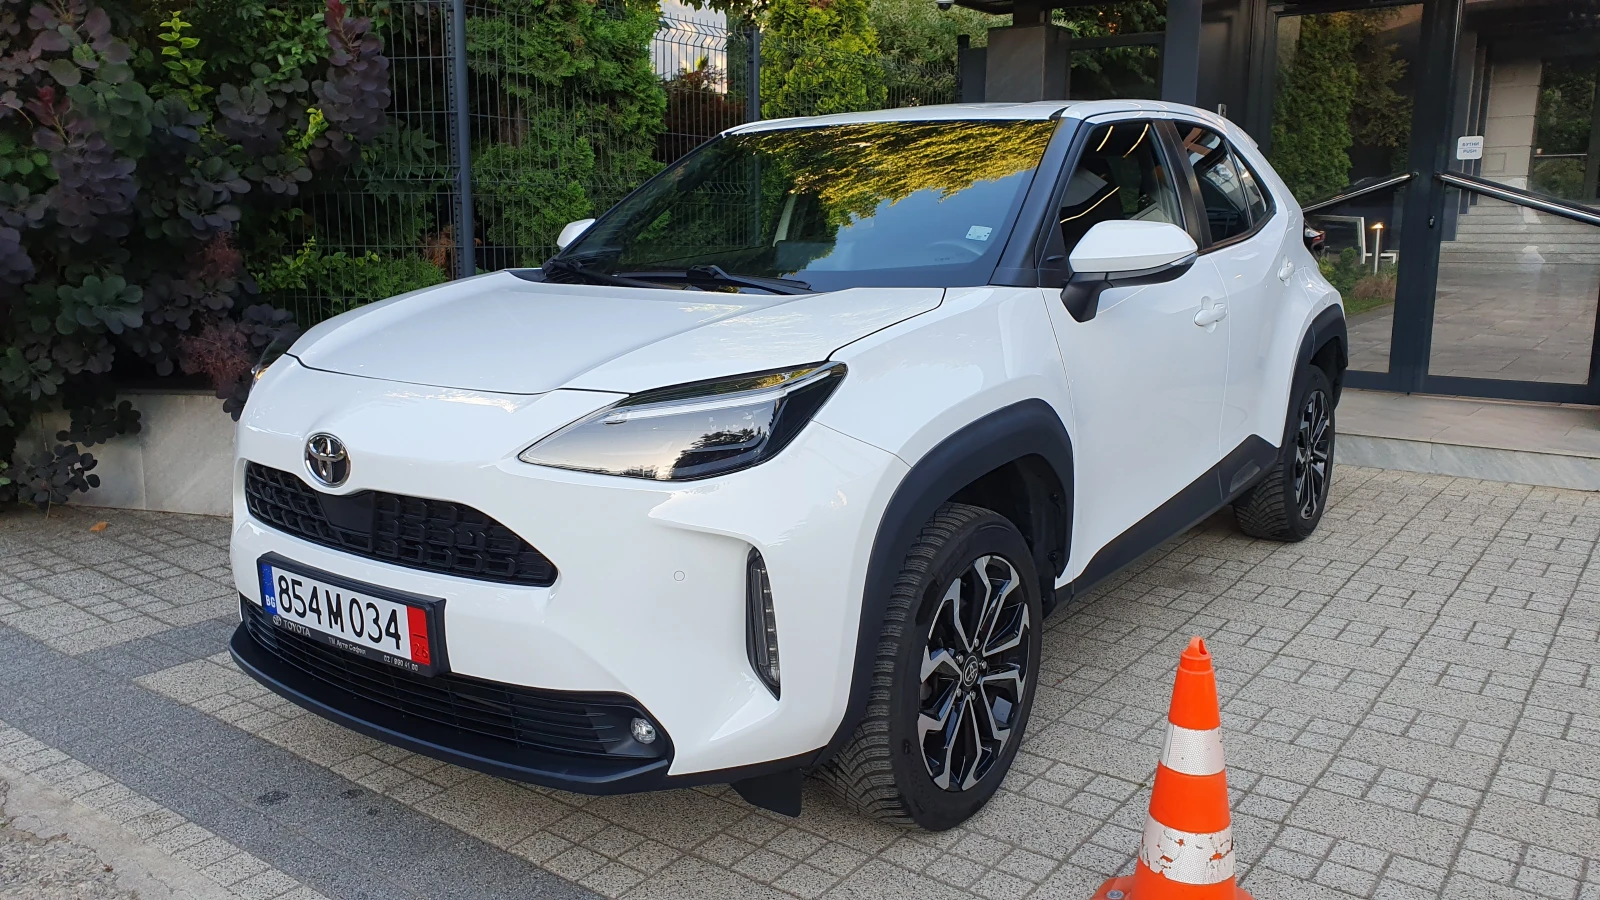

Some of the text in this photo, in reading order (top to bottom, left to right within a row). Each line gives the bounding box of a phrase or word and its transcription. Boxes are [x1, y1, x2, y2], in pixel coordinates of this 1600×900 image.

[265, 575, 402, 651] BG 854M034
[284, 619, 311, 637] TOYOTA
[413, 643, 429, 659] 26
